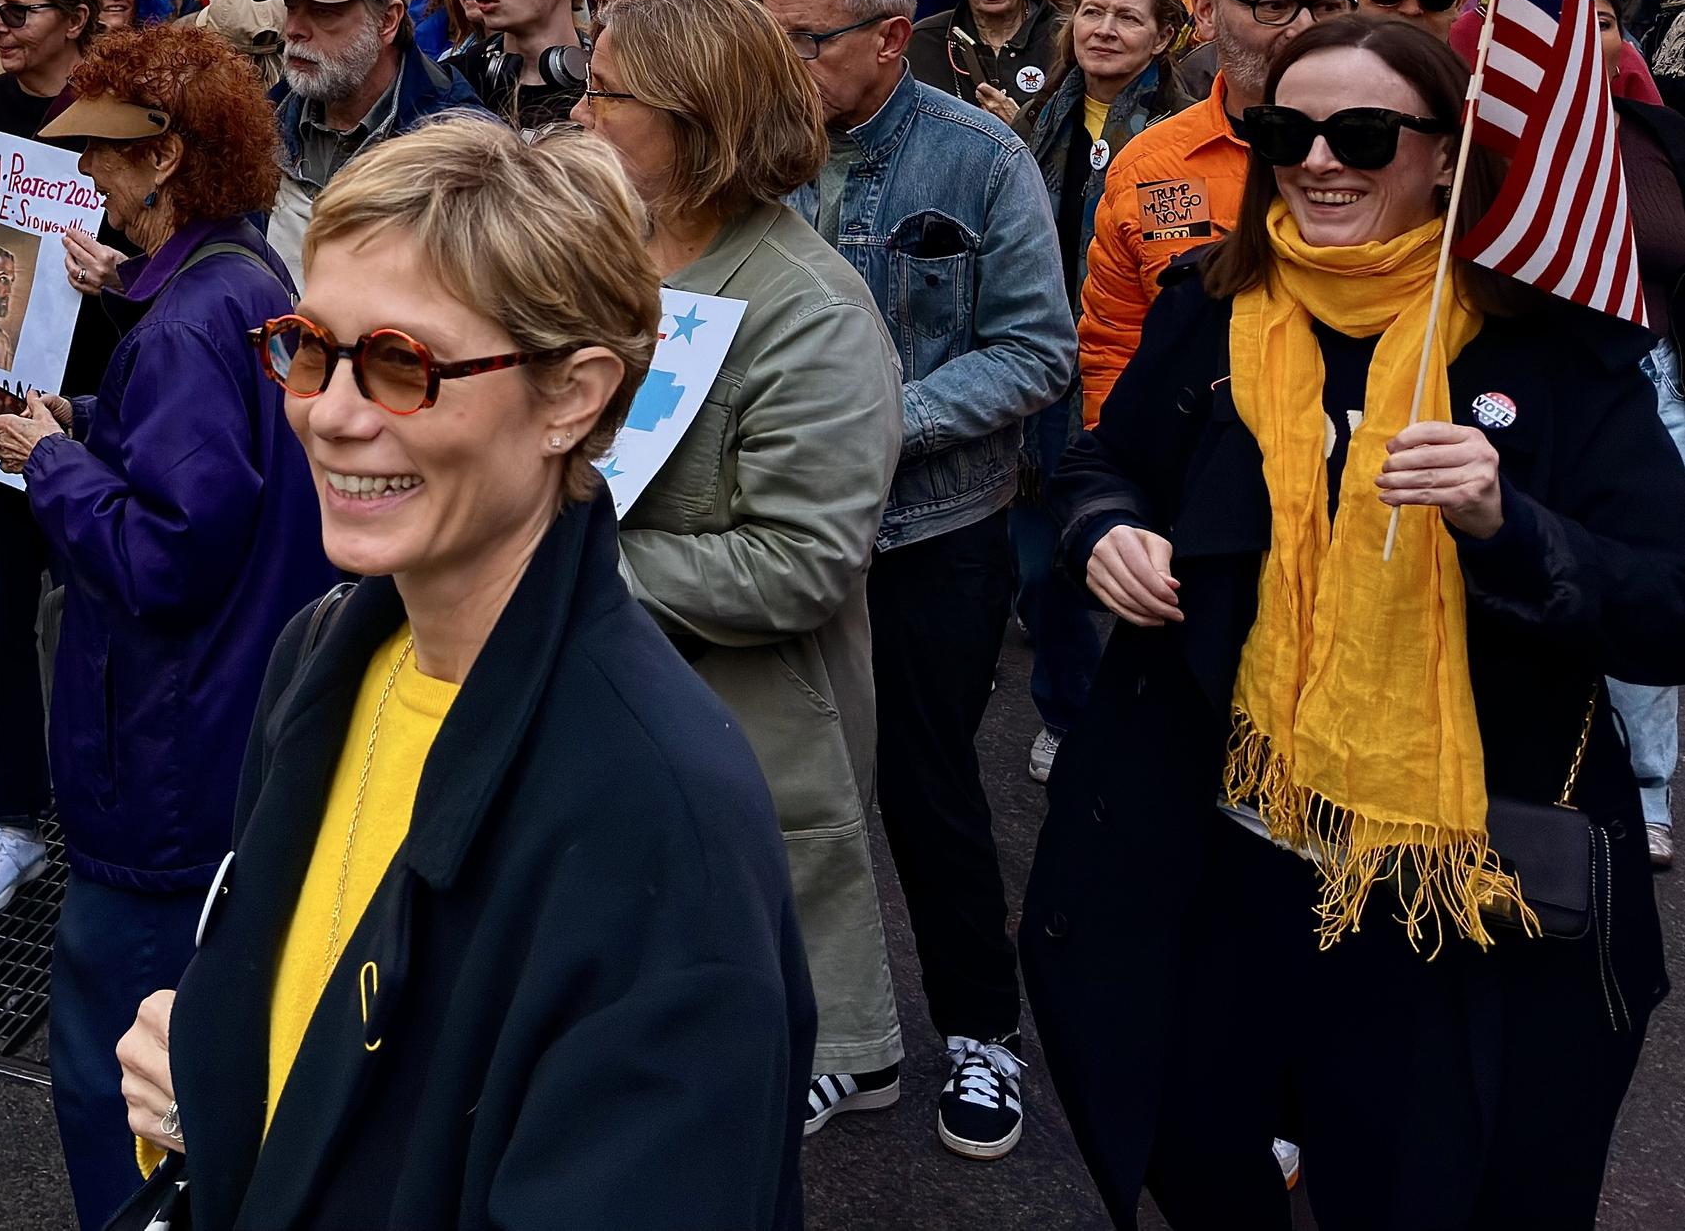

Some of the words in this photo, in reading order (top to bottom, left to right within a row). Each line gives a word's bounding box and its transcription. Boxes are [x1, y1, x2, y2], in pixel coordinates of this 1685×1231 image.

[1148, 183, 1190, 203] TRUMP
[1143, 198, 1176, 216] MUST
[1179, 194, 1202, 208] GO
[1475, 396, 1513, 424] VOTE
